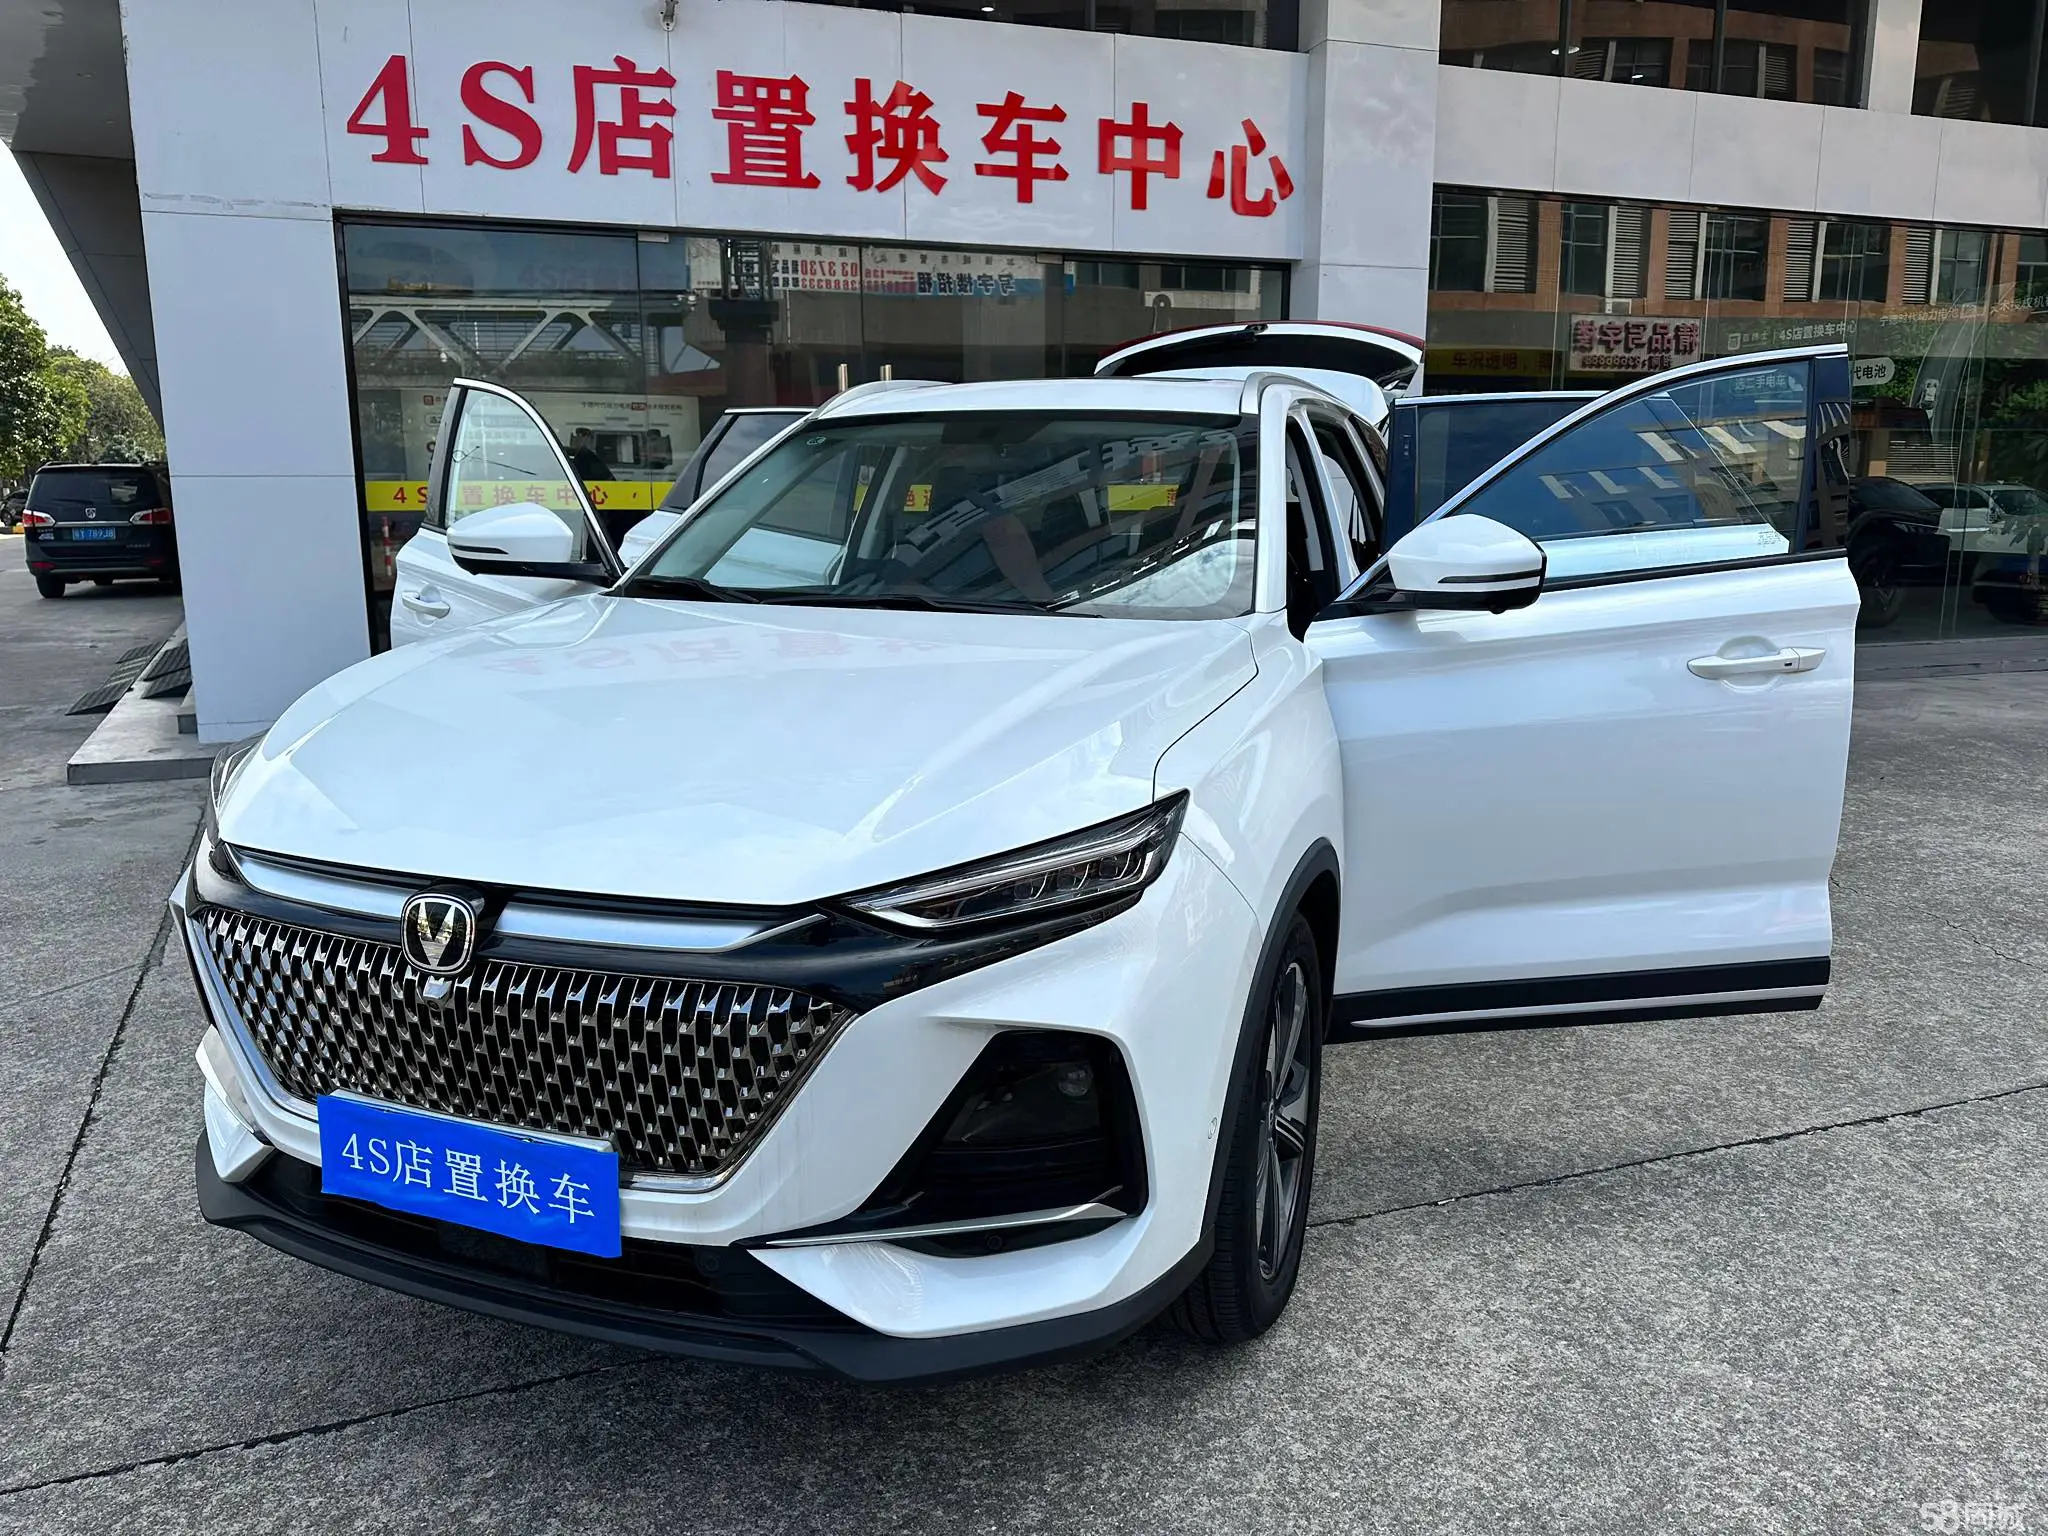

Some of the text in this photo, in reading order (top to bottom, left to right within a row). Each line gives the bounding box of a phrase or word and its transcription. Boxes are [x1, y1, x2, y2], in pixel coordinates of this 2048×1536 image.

[346, 54, 1294, 218] 4S店置换车中心
[1777, 319, 1858, 341] 4S店置换车中心
[341, 1132, 595, 1225] 4S店置换车
